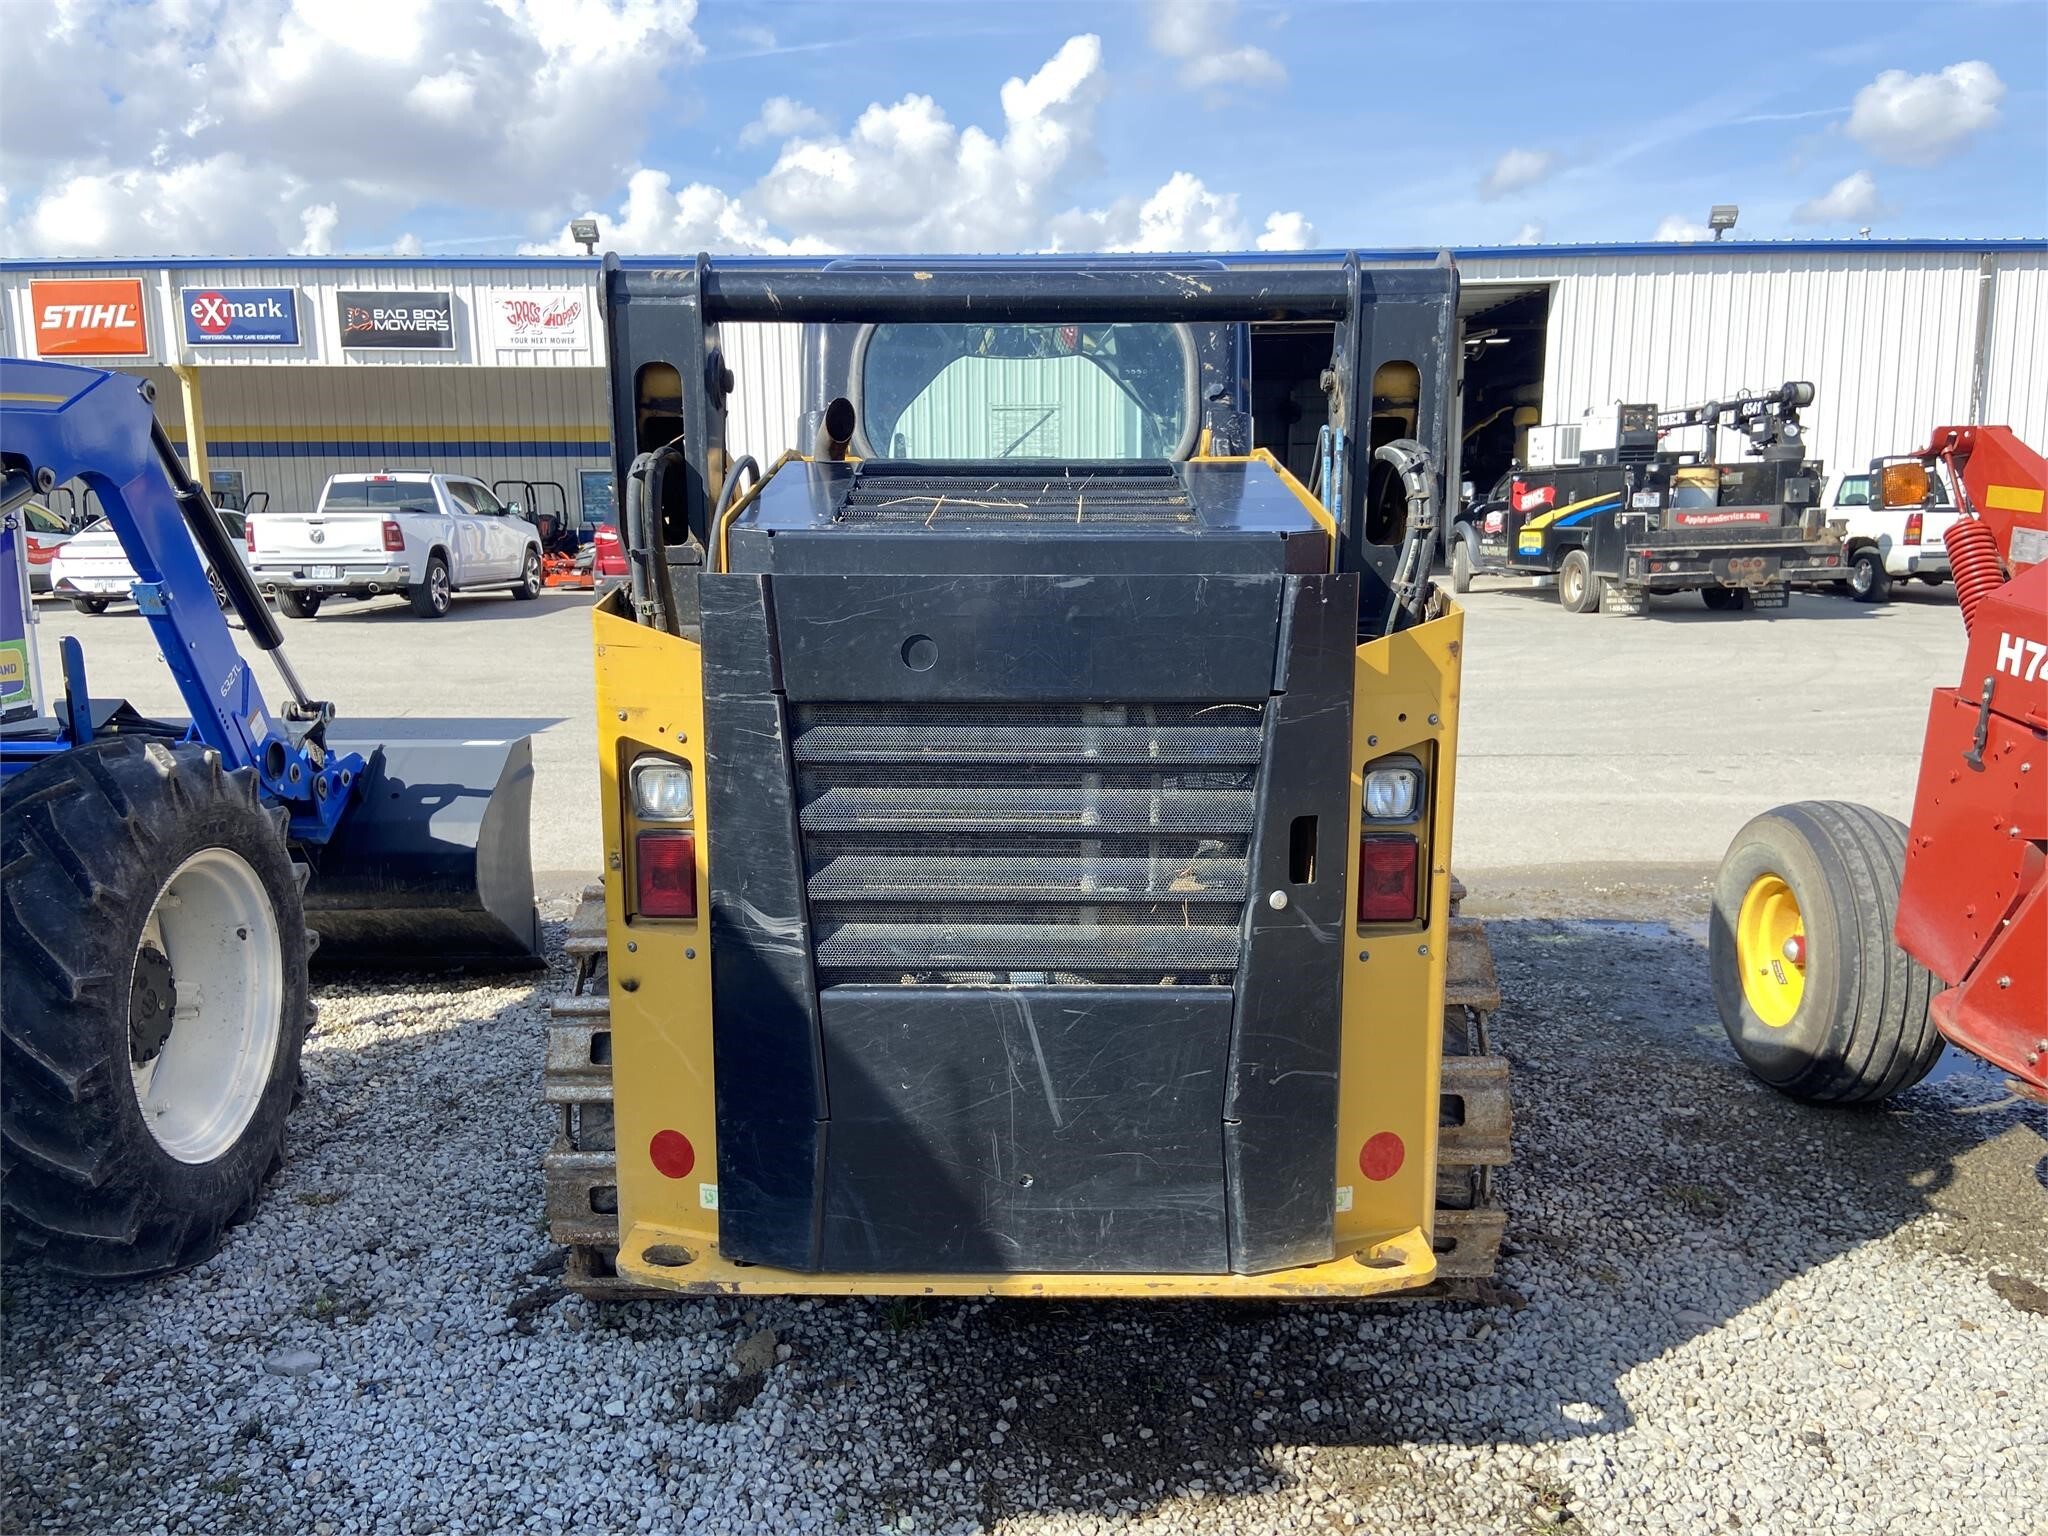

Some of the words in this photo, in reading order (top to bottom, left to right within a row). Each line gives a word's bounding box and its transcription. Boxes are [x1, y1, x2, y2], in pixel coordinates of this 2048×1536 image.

[41, 304, 137, 329] STIHL
[190, 298, 281, 327] eXmark
[373, 308, 408, 320] BAD
[413, 309, 448, 320] BOY
[374, 319, 450, 331] MOWERS
[1520, 487, 1546, 511] SERVICE
[1684, 512, 1760, 525] AppleFarmService.com
[221, 664, 242, 697] 632TL
